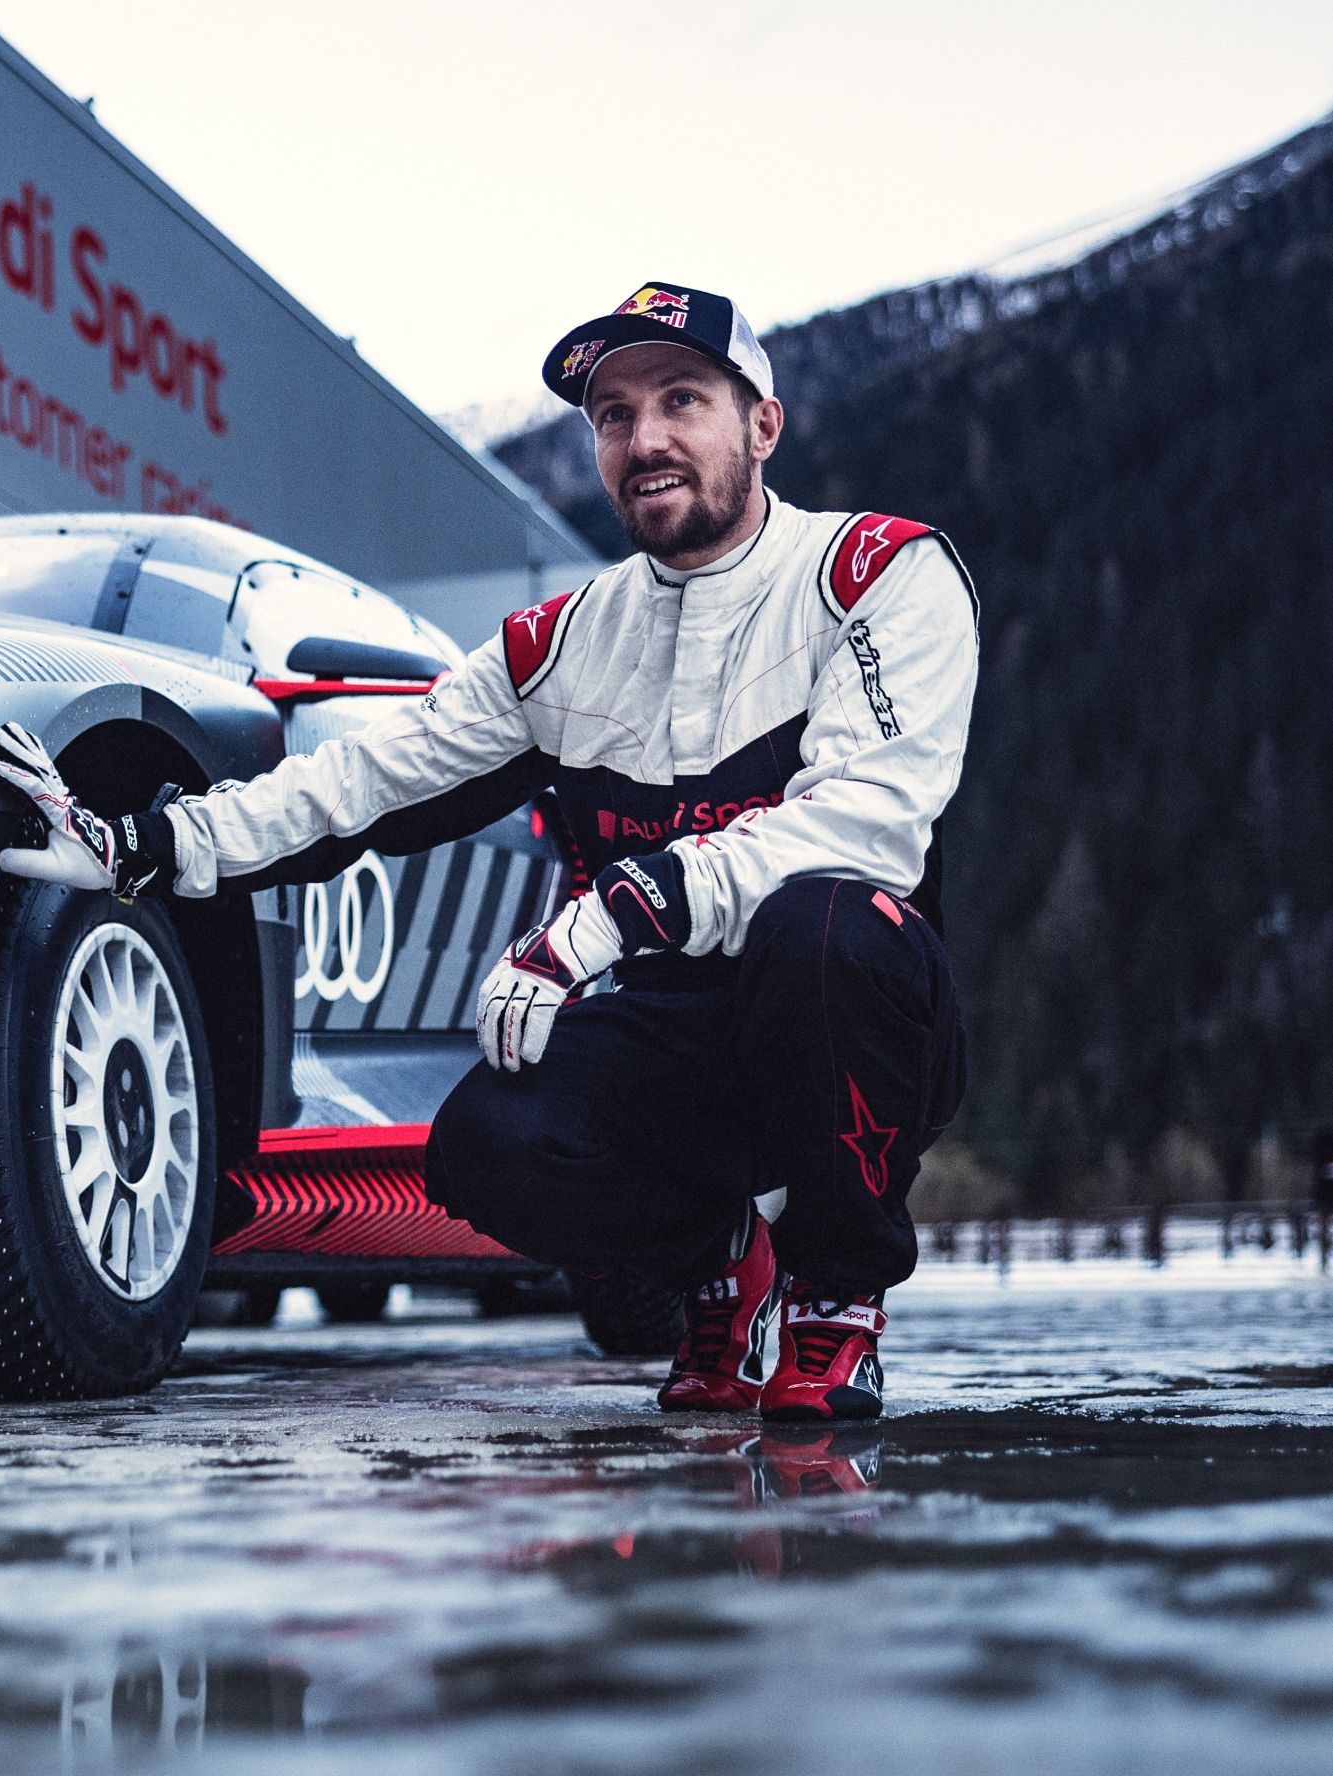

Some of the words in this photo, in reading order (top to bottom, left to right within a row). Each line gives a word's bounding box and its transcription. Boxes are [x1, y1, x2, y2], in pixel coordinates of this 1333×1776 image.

[69, 223, 227, 437] Sport
[622, 802, 686, 841] Aui
[842, 1308, 870, 1321] Sport
